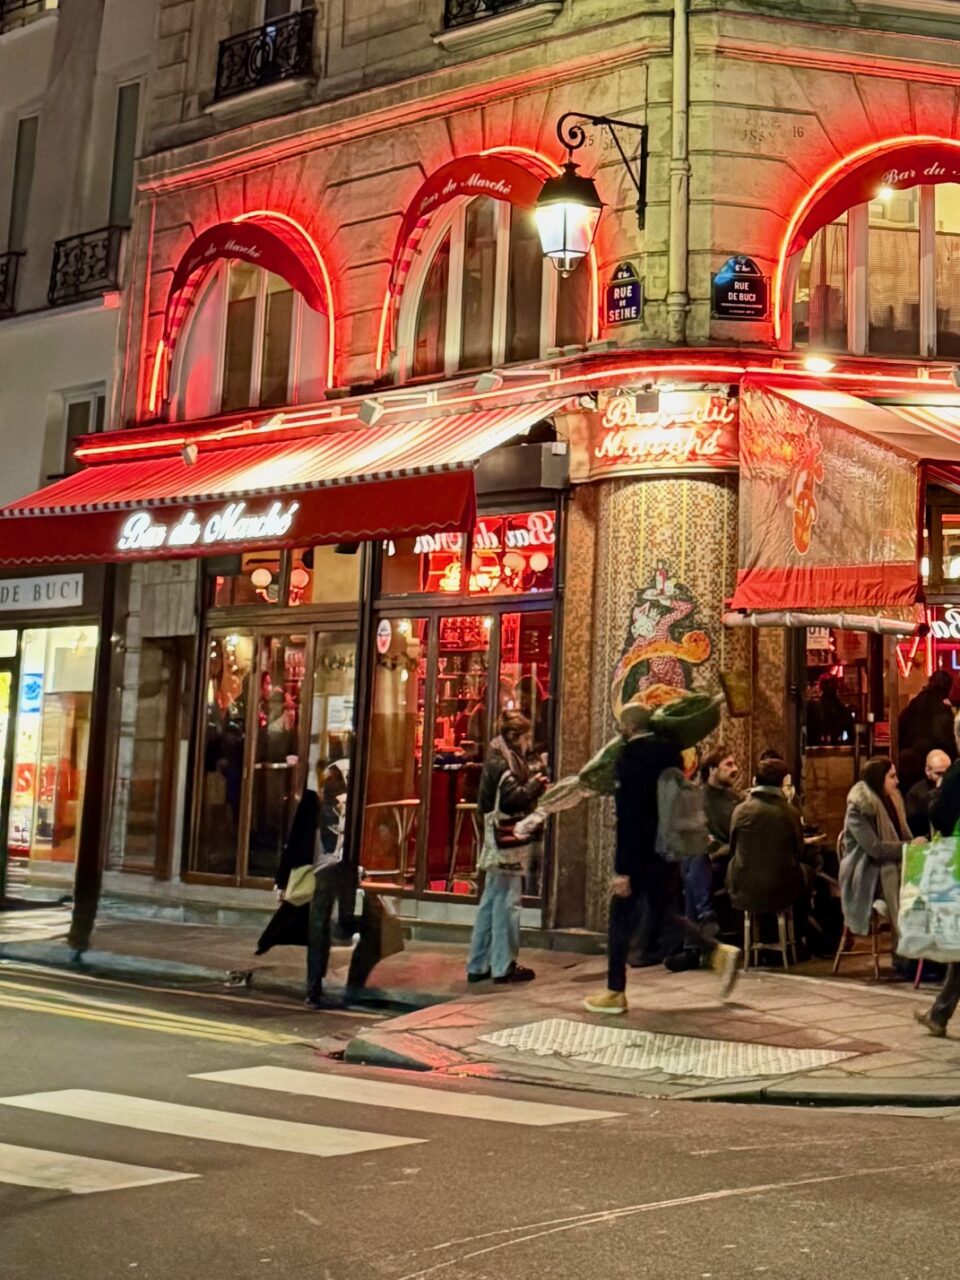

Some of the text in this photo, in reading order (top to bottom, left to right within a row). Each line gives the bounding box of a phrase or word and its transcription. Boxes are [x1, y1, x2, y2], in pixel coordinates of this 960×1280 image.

[792, 125, 804, 138] 16
[881, 169, 916, 185] Bar
[923, 161, 946, 176] du
[442, 178, 457, 195] du
[460, 173, 513, 195] Marché
[613, 285, 633, 300] RUE
[734, 281, 750, 291] RUE
[727, 291, 757, 302] DE BUCI
[608, 306, 638, 322] SEINE
[692, 393, 735, 423] du
[117, 501, 300, 551] Bar du Marché
[1, 580, 79, 604] DE BUCI
